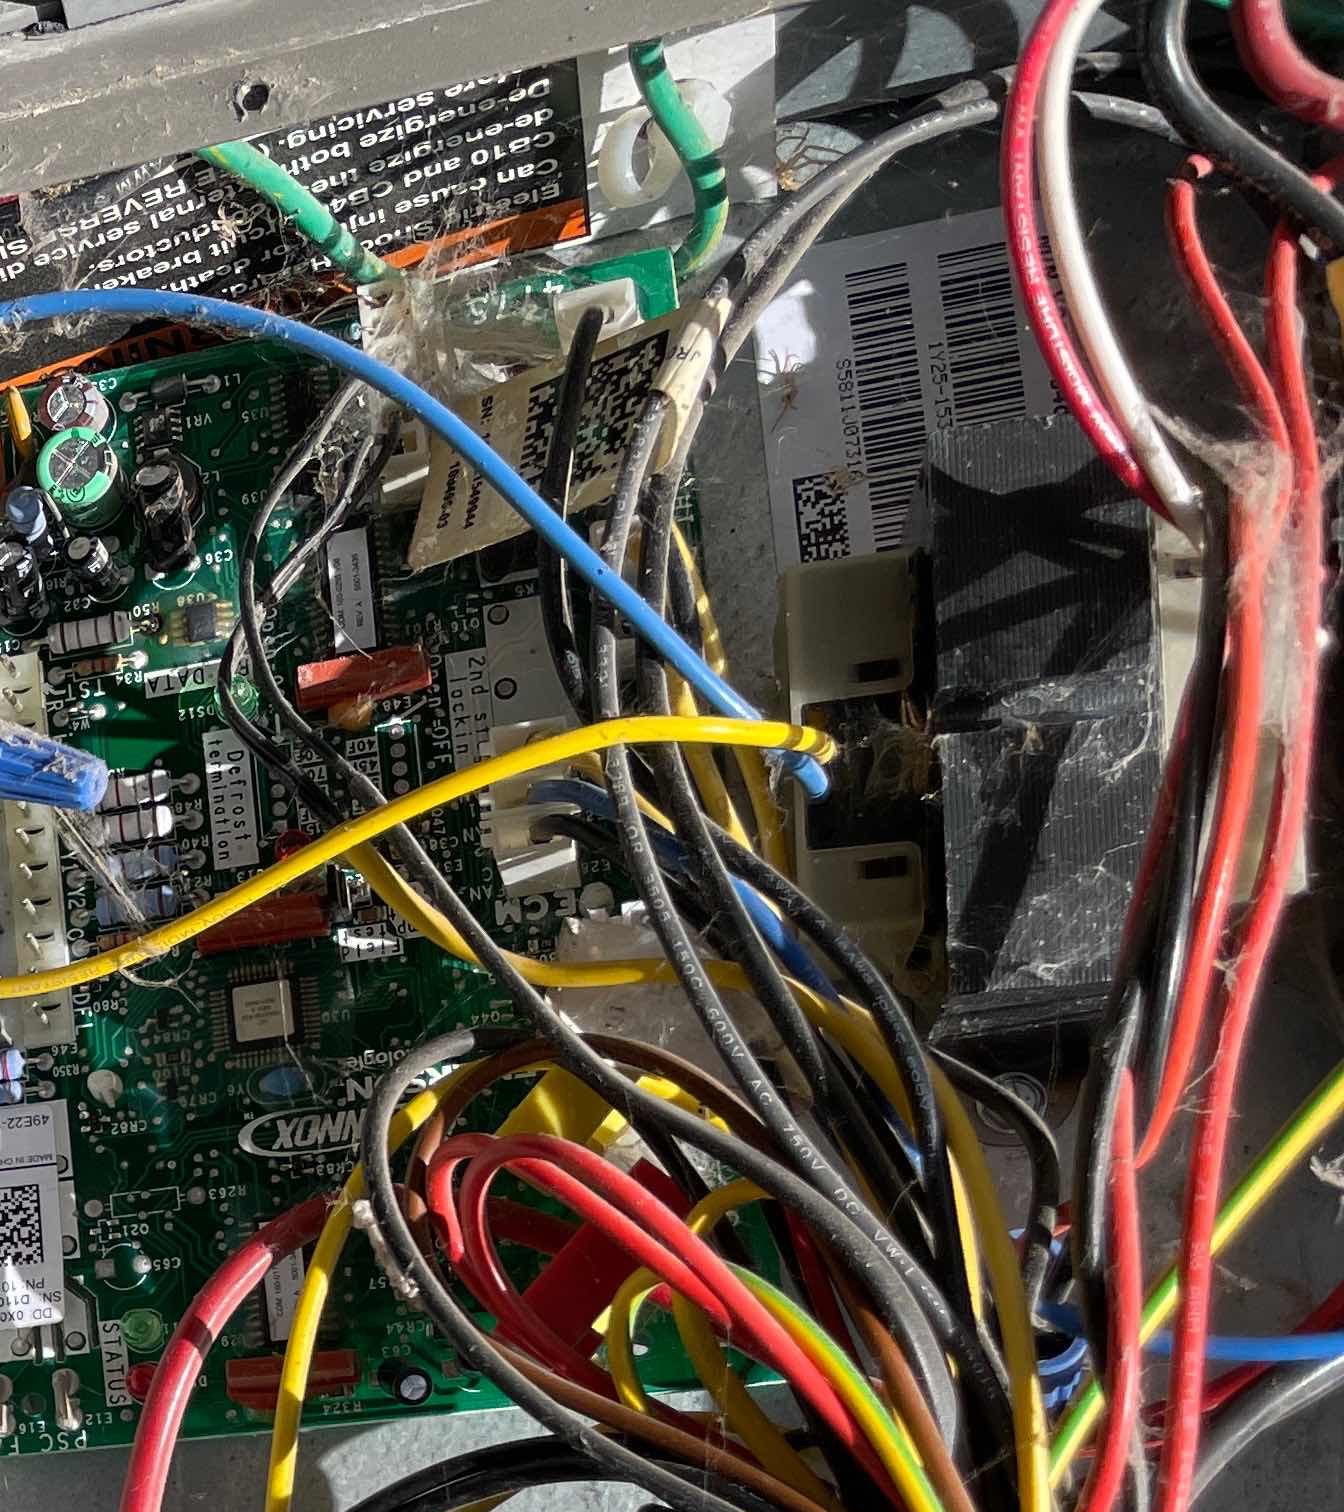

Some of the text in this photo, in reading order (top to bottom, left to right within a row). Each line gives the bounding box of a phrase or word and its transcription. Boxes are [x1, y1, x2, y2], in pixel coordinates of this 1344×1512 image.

[278, 91, 434, 150] servicing.
[359, 78, 550, 148] De-energize
[368, 108, 554, 174] de-energize
[470, 131, 555, 167] CB10
[403, 157, 461, 188] and
[497, 158, 558, 186] Can
[394, 176, 487, 215] cause
[33, 219, 141, 266] service
[480, 395, 493, 424] SN:
[186, 413, 211, 429] VR1
[200, 470, 220, 482] L2
[205, 549, 233, 563] C36
[63, 597, 91, 612] C32
[132, 601, 160, 619] R50
[114, 670, 144, 686] R34
[146, 667, 205, 692] DATA
[467, 656, 487, 695] 2nd
[63, 680, 105, 702] TST
[346, 739, 377, 752] 40F
[208, 738, 231, 862] termination
[225, 750, 251, 842] Defrost
[174, 800, 202, 812] R48
[181, 834, 209, 848] R40
[493, 889, 575, 925] ECM
[52, 1063, 80, 1076] R350
[699, 1006, 745, 1061] 600V
[748, 1075, 773, 1111] AC
[780, 1122, 826, 1174] 750V
[829, 1185, 859, 1218] DC
[111, 1120, 147, 1135] CR82
[15, 1156, 25, 1165] IN
[28, 1153, 53, 1165] MADE
[208, 1185, 246, 1199] R263
[152, 1256, 181, 1269] C65
[39, 1290, 62, 1302] SN:
[32, 1307, 52, 1319] DD
[100, 1321, 127, 1407] STATUS
[322, 1401, 361, 1414] R324
[85, 1411, 112, 1426] E12
[18, 1421, 46, 1435] E16
[39, 1430, 88, 1451] PSC
